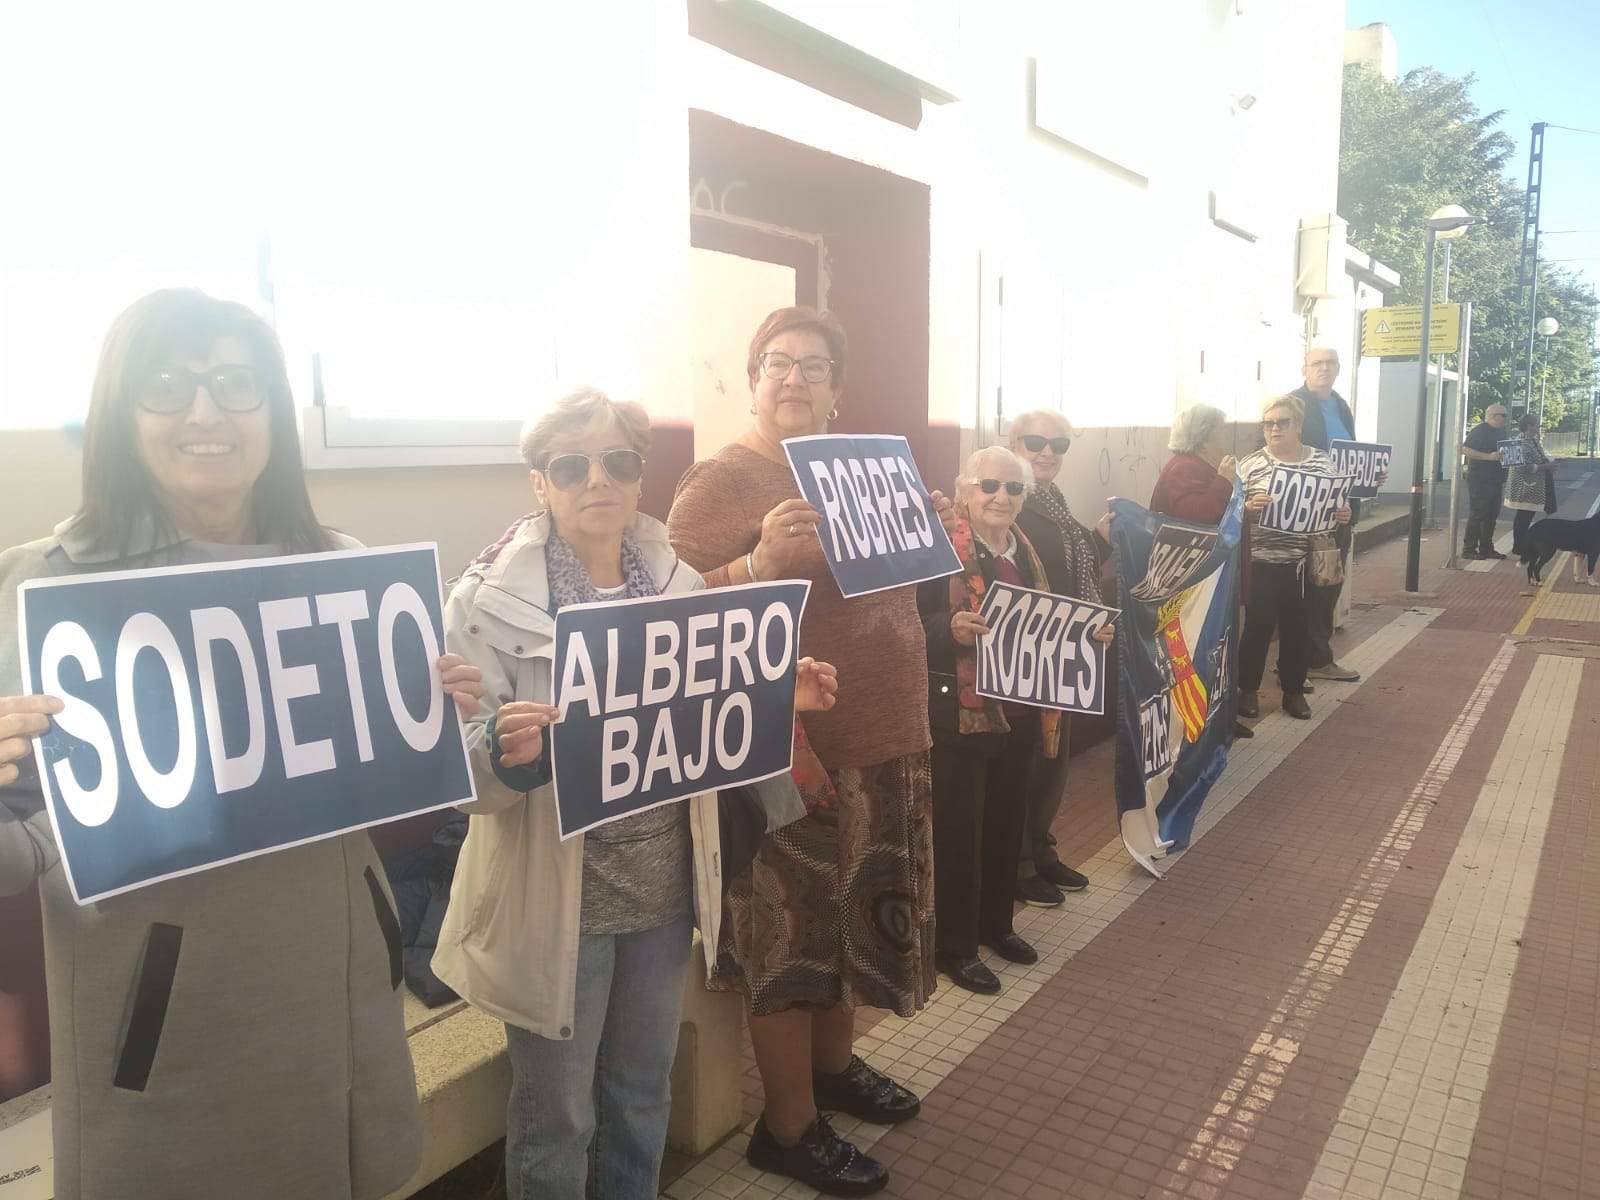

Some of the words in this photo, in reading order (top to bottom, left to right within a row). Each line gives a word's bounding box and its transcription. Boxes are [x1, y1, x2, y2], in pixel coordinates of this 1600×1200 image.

[809, 456, 933, 562] ROBRES
[1263, 469, 1353, 533] ROBRES
[41, 582, 444, 827] SODETO
[557, 601, 793, 723] ALBERO
[981, 588, 1109, 709] ROBRES
[602, 691, 752, 803] BAJO
